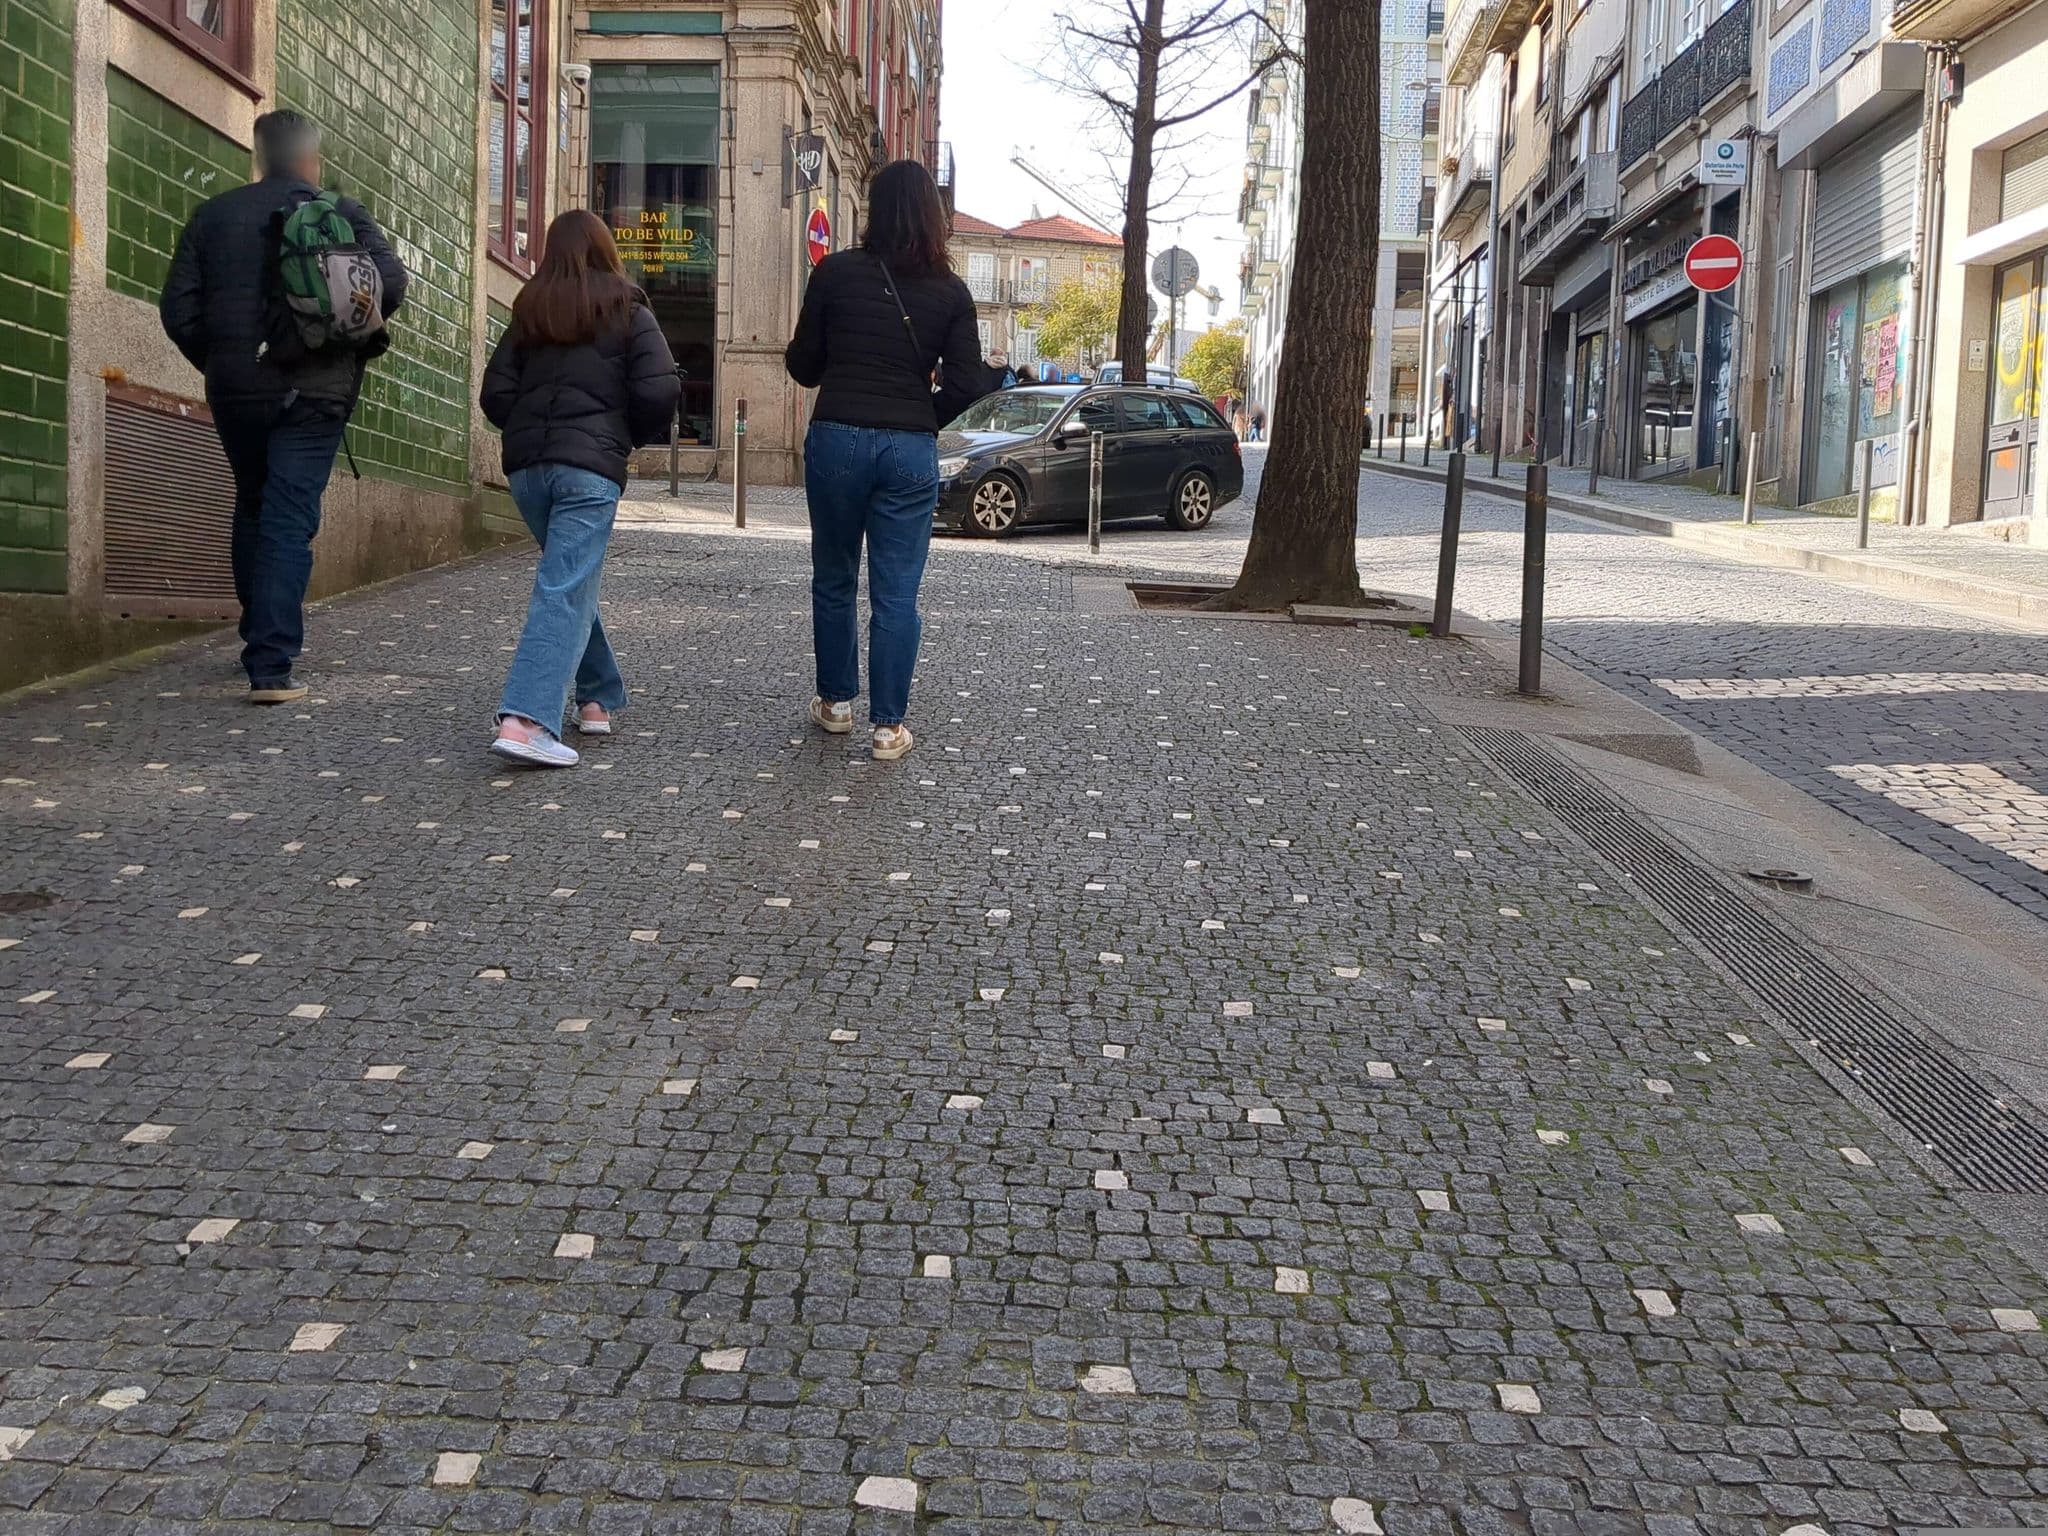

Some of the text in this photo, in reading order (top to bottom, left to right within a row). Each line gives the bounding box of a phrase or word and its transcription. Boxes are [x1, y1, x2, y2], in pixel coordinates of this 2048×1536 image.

[640, 211, 668, 223] BAR
[614, 228, 694, 240] TO BE WILD
[642, 264, 664, 273] PORTO
